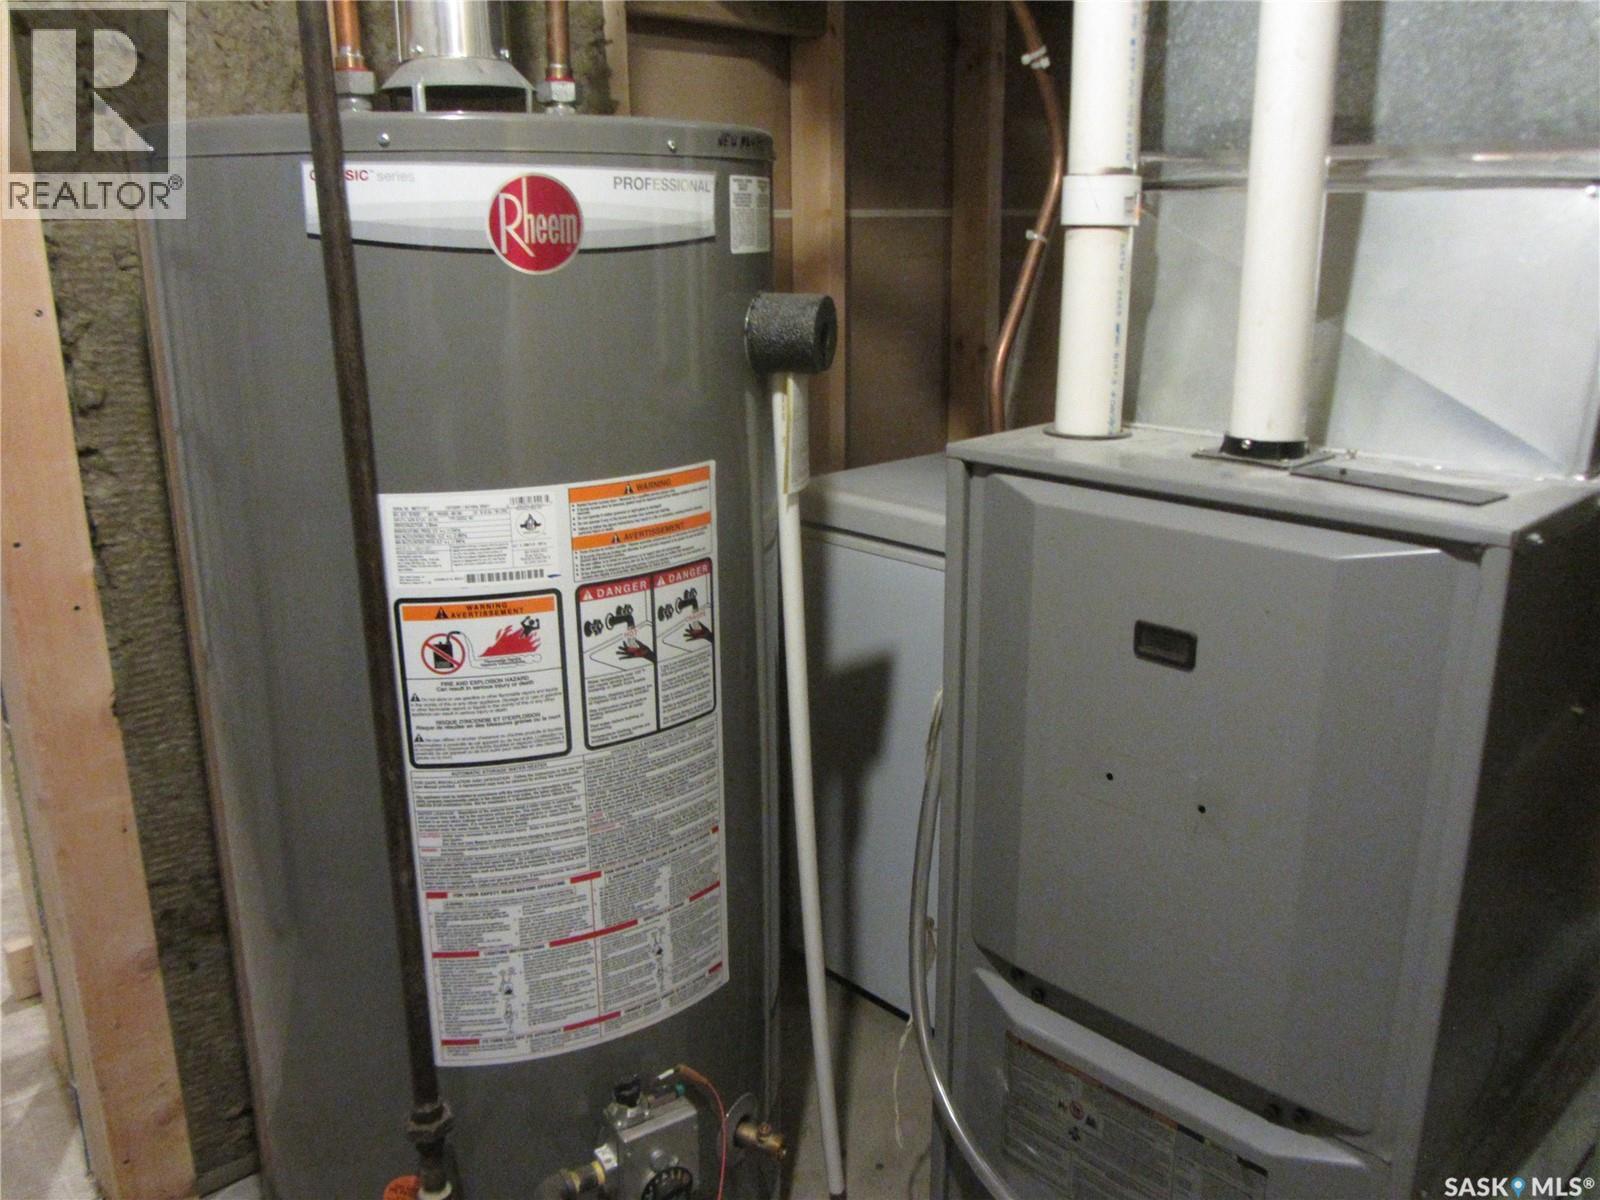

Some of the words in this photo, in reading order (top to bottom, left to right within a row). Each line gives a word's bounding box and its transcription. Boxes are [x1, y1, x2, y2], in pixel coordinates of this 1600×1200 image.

[613, 176, 711, 193] PROFESSIONAL
[498, 177, 578, 257] Rheem
[636, 478, 672, 491] WARNING
[624, 522, 684, 540] AVERTISSEMENT
[668, 564, 708, 583] DANGER
[596, 580, 647, 598] DANGER
[450, 607, 524, 619] AVERTISSEMENT
[466, 602, 508, 611] WARNING
